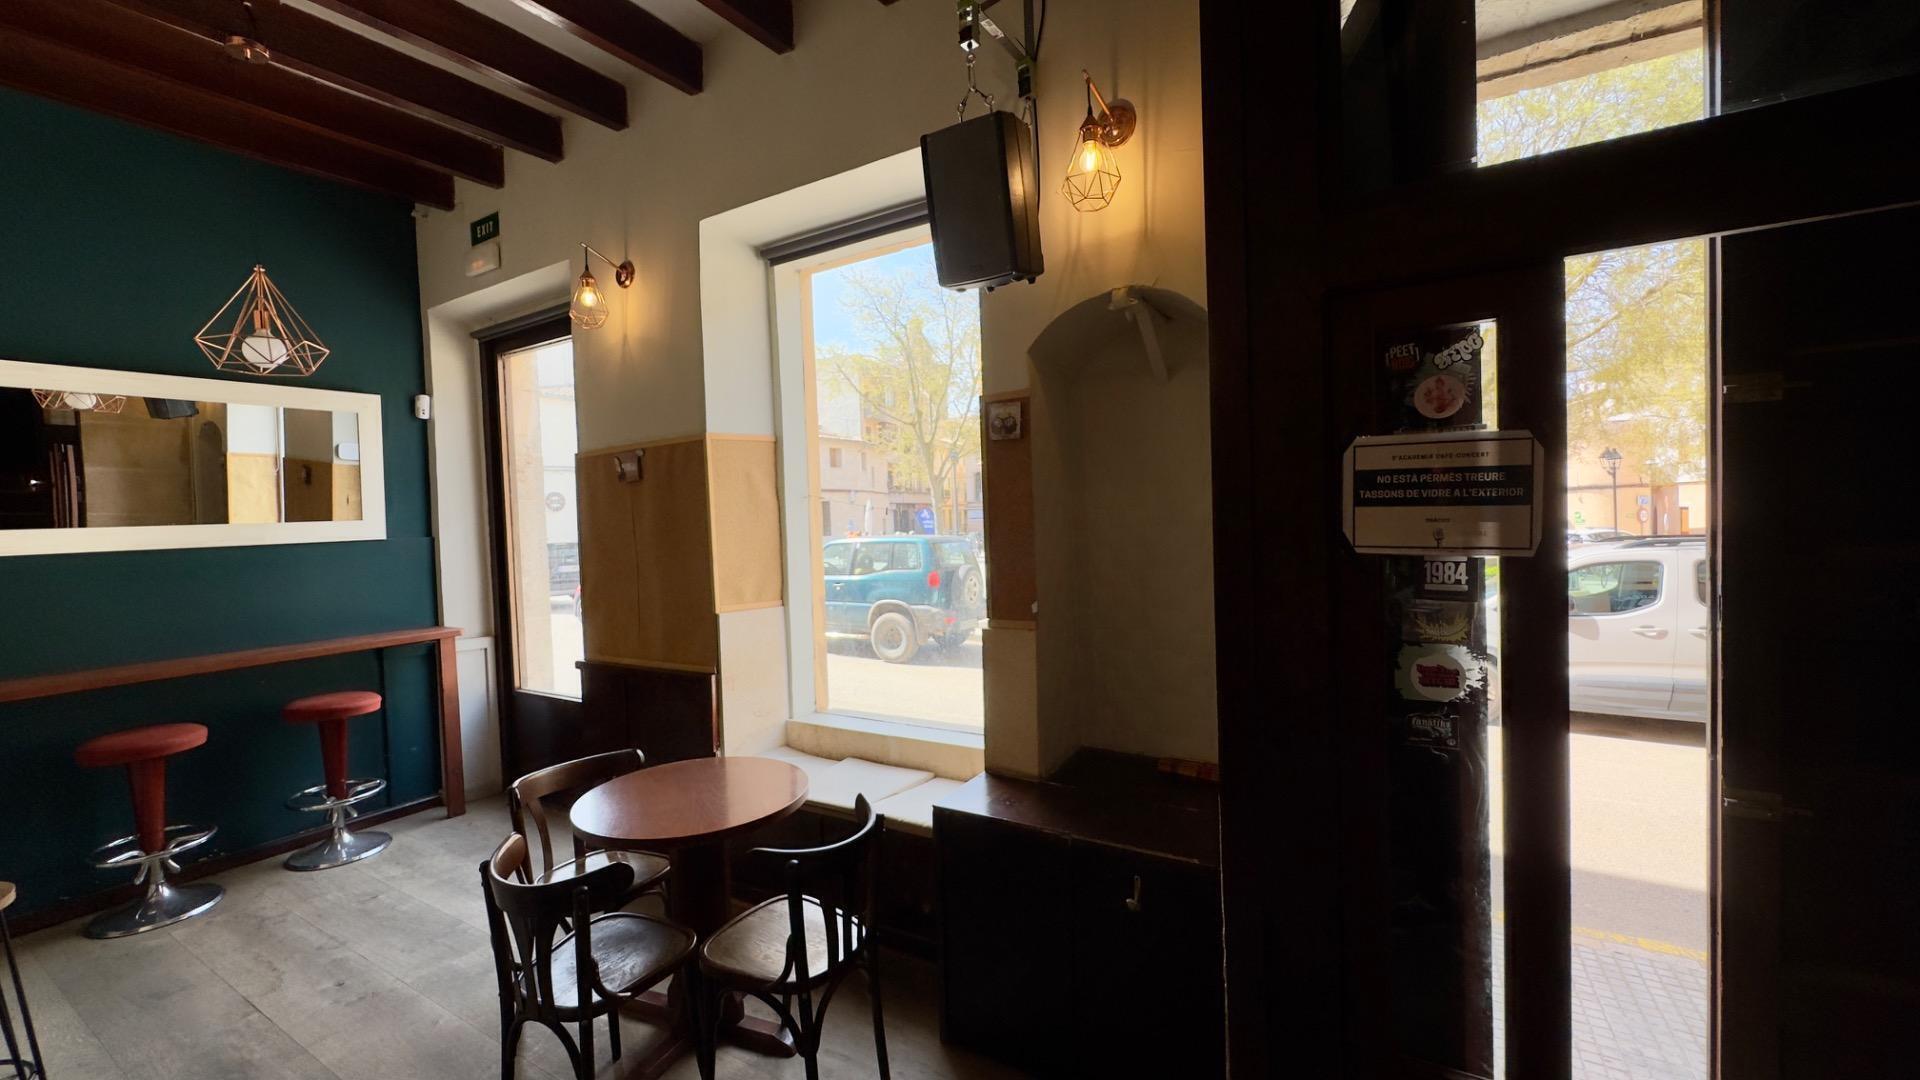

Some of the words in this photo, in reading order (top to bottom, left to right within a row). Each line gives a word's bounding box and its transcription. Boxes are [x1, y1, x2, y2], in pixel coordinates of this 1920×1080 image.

[476, 221, 494, 238] EXIT
[1376, 474, 1391, 484] NO
[1464, 471, 1505, 482] TREURE
[1359, 489, 1404, 499] TASSONS
[1406, 489, 1420, 498] DE
[1422, 488, 1451, 498] VIDRE
[1454, 488, 1461, 497] A
[1463, 487, 1524, 497] L'EXTERIOR
[1424, 561, 1469, 585] 1984
